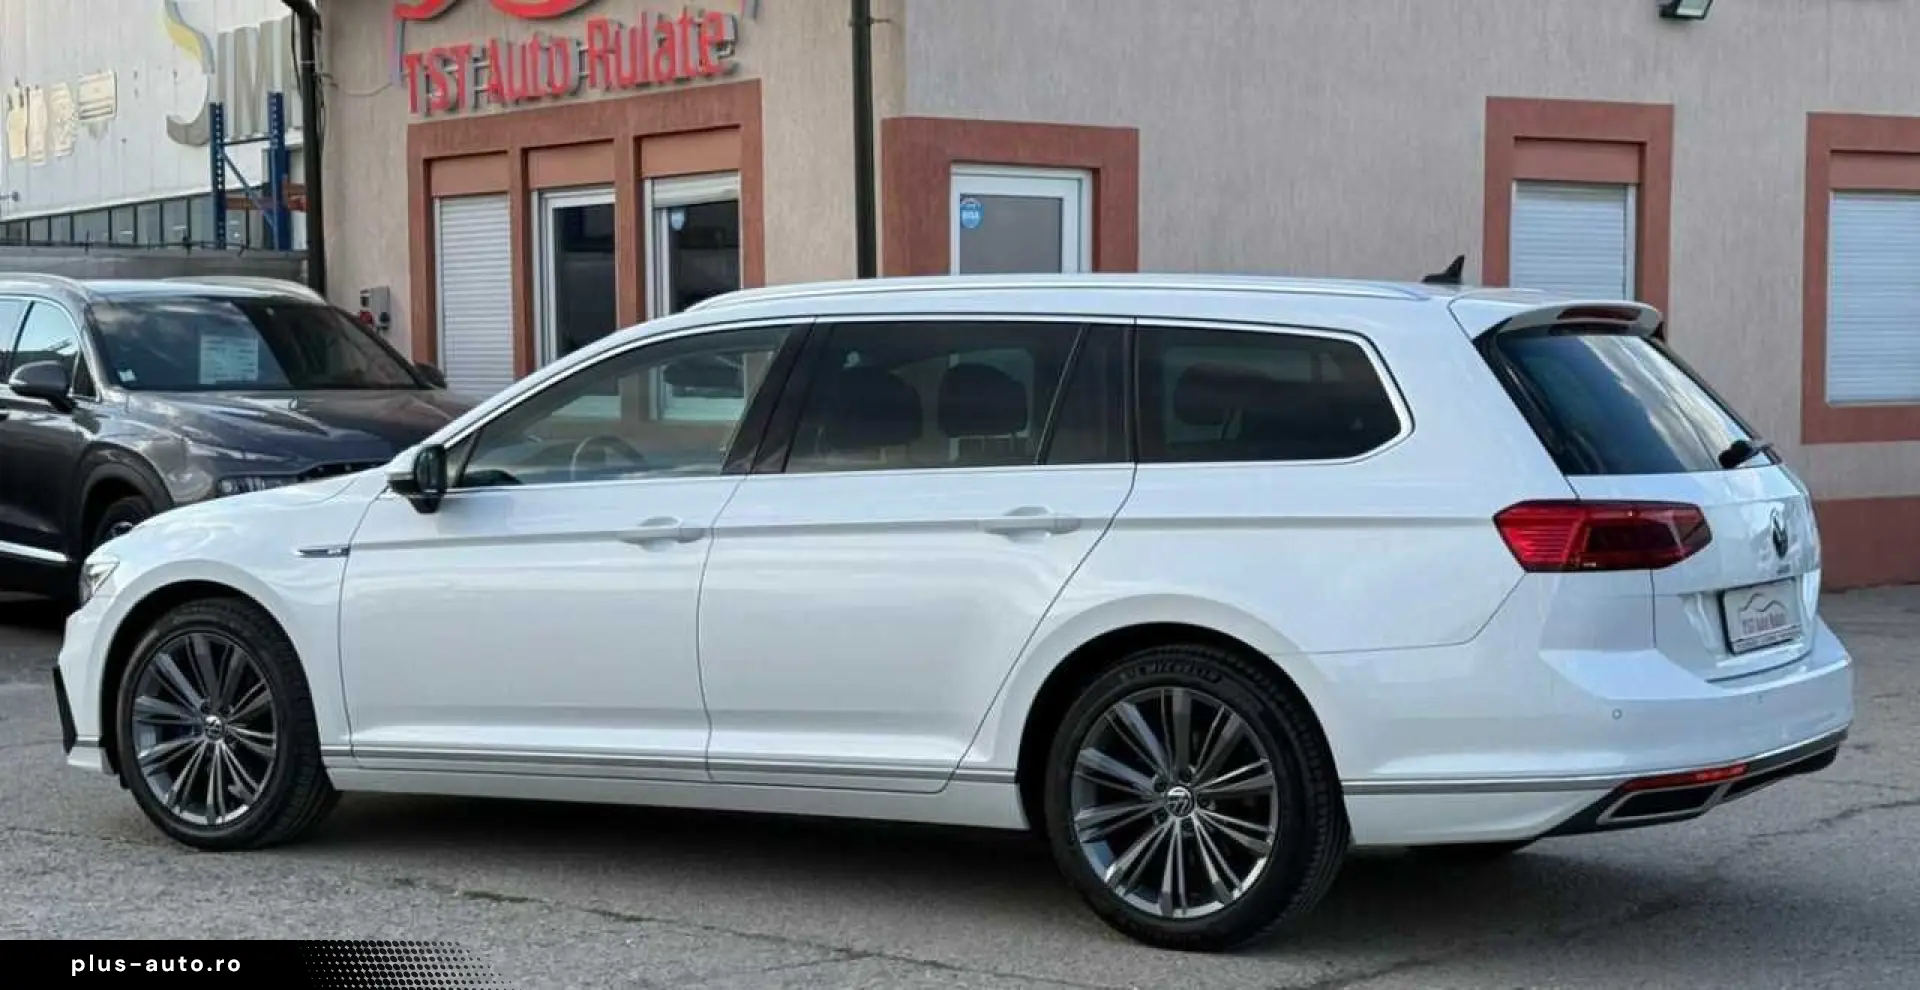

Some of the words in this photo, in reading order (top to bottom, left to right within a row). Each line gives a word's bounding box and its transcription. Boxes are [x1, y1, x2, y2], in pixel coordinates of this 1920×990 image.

[403, 41, 473, 115] TST
[484, 32, 576, 105] Auto
[587, 7, 730, 89] Rulate
